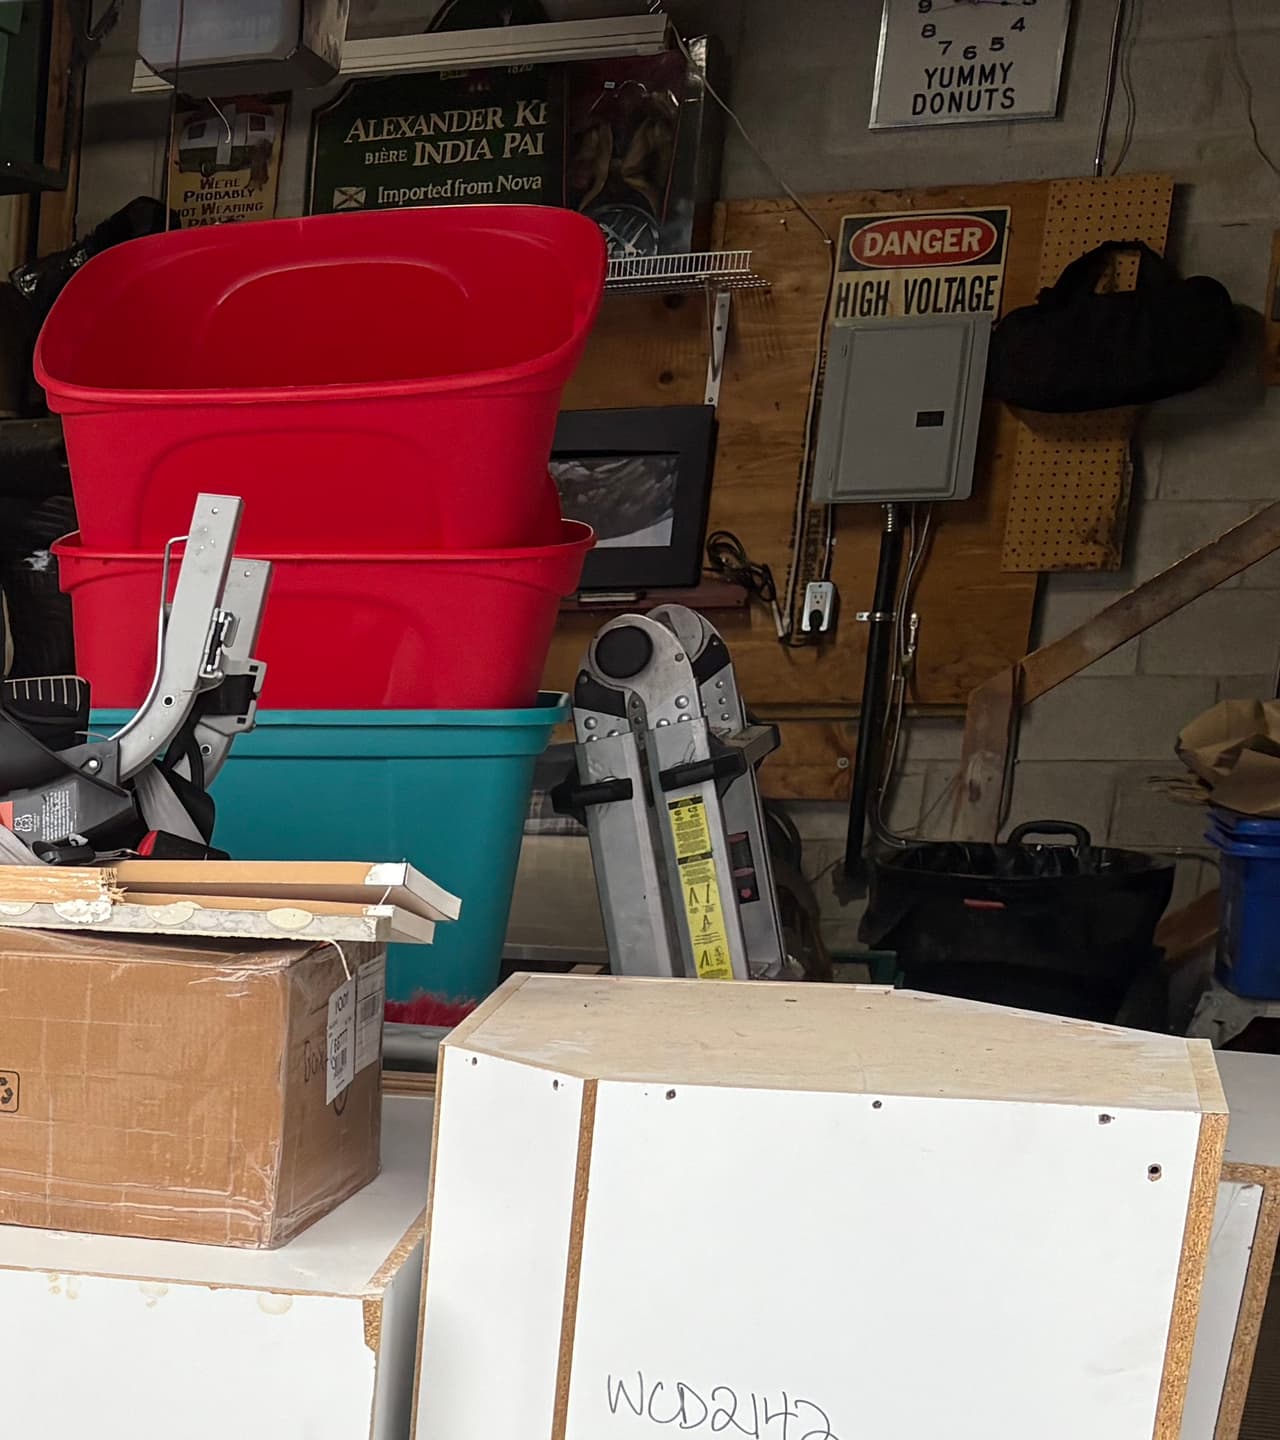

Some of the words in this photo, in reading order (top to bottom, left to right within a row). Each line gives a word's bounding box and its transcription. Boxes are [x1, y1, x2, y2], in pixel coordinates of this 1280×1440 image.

[918, 0, 932, 13] 9
[921, 24, 936, 38] 8
[1011, 17, 1026, 32] 4
[938, 41, 952, 55] 7
[963, 45, 977, 60] 6
[989, 37, 1004, 51] 5
[924, 61, 1013, 89] YUMMY
[912, 88, 1015, 115] DONUTS
[344, 106, 504, 143] ALEXANDER
[364, 146, 407, 165] BIÈRE
[412, 137, 493, 167] INDIA
[183, 188, 255, 203] PROBABLY
[378, 178, 452, 204] Imported
[453, 177, 494, 198] from
[496, 174, 542, 192] Nova
[863, 227, 983, 257] DANGER
[834, 280, 890, 318] HIGH
[903, 275, 998, 315] VOLTAGE
